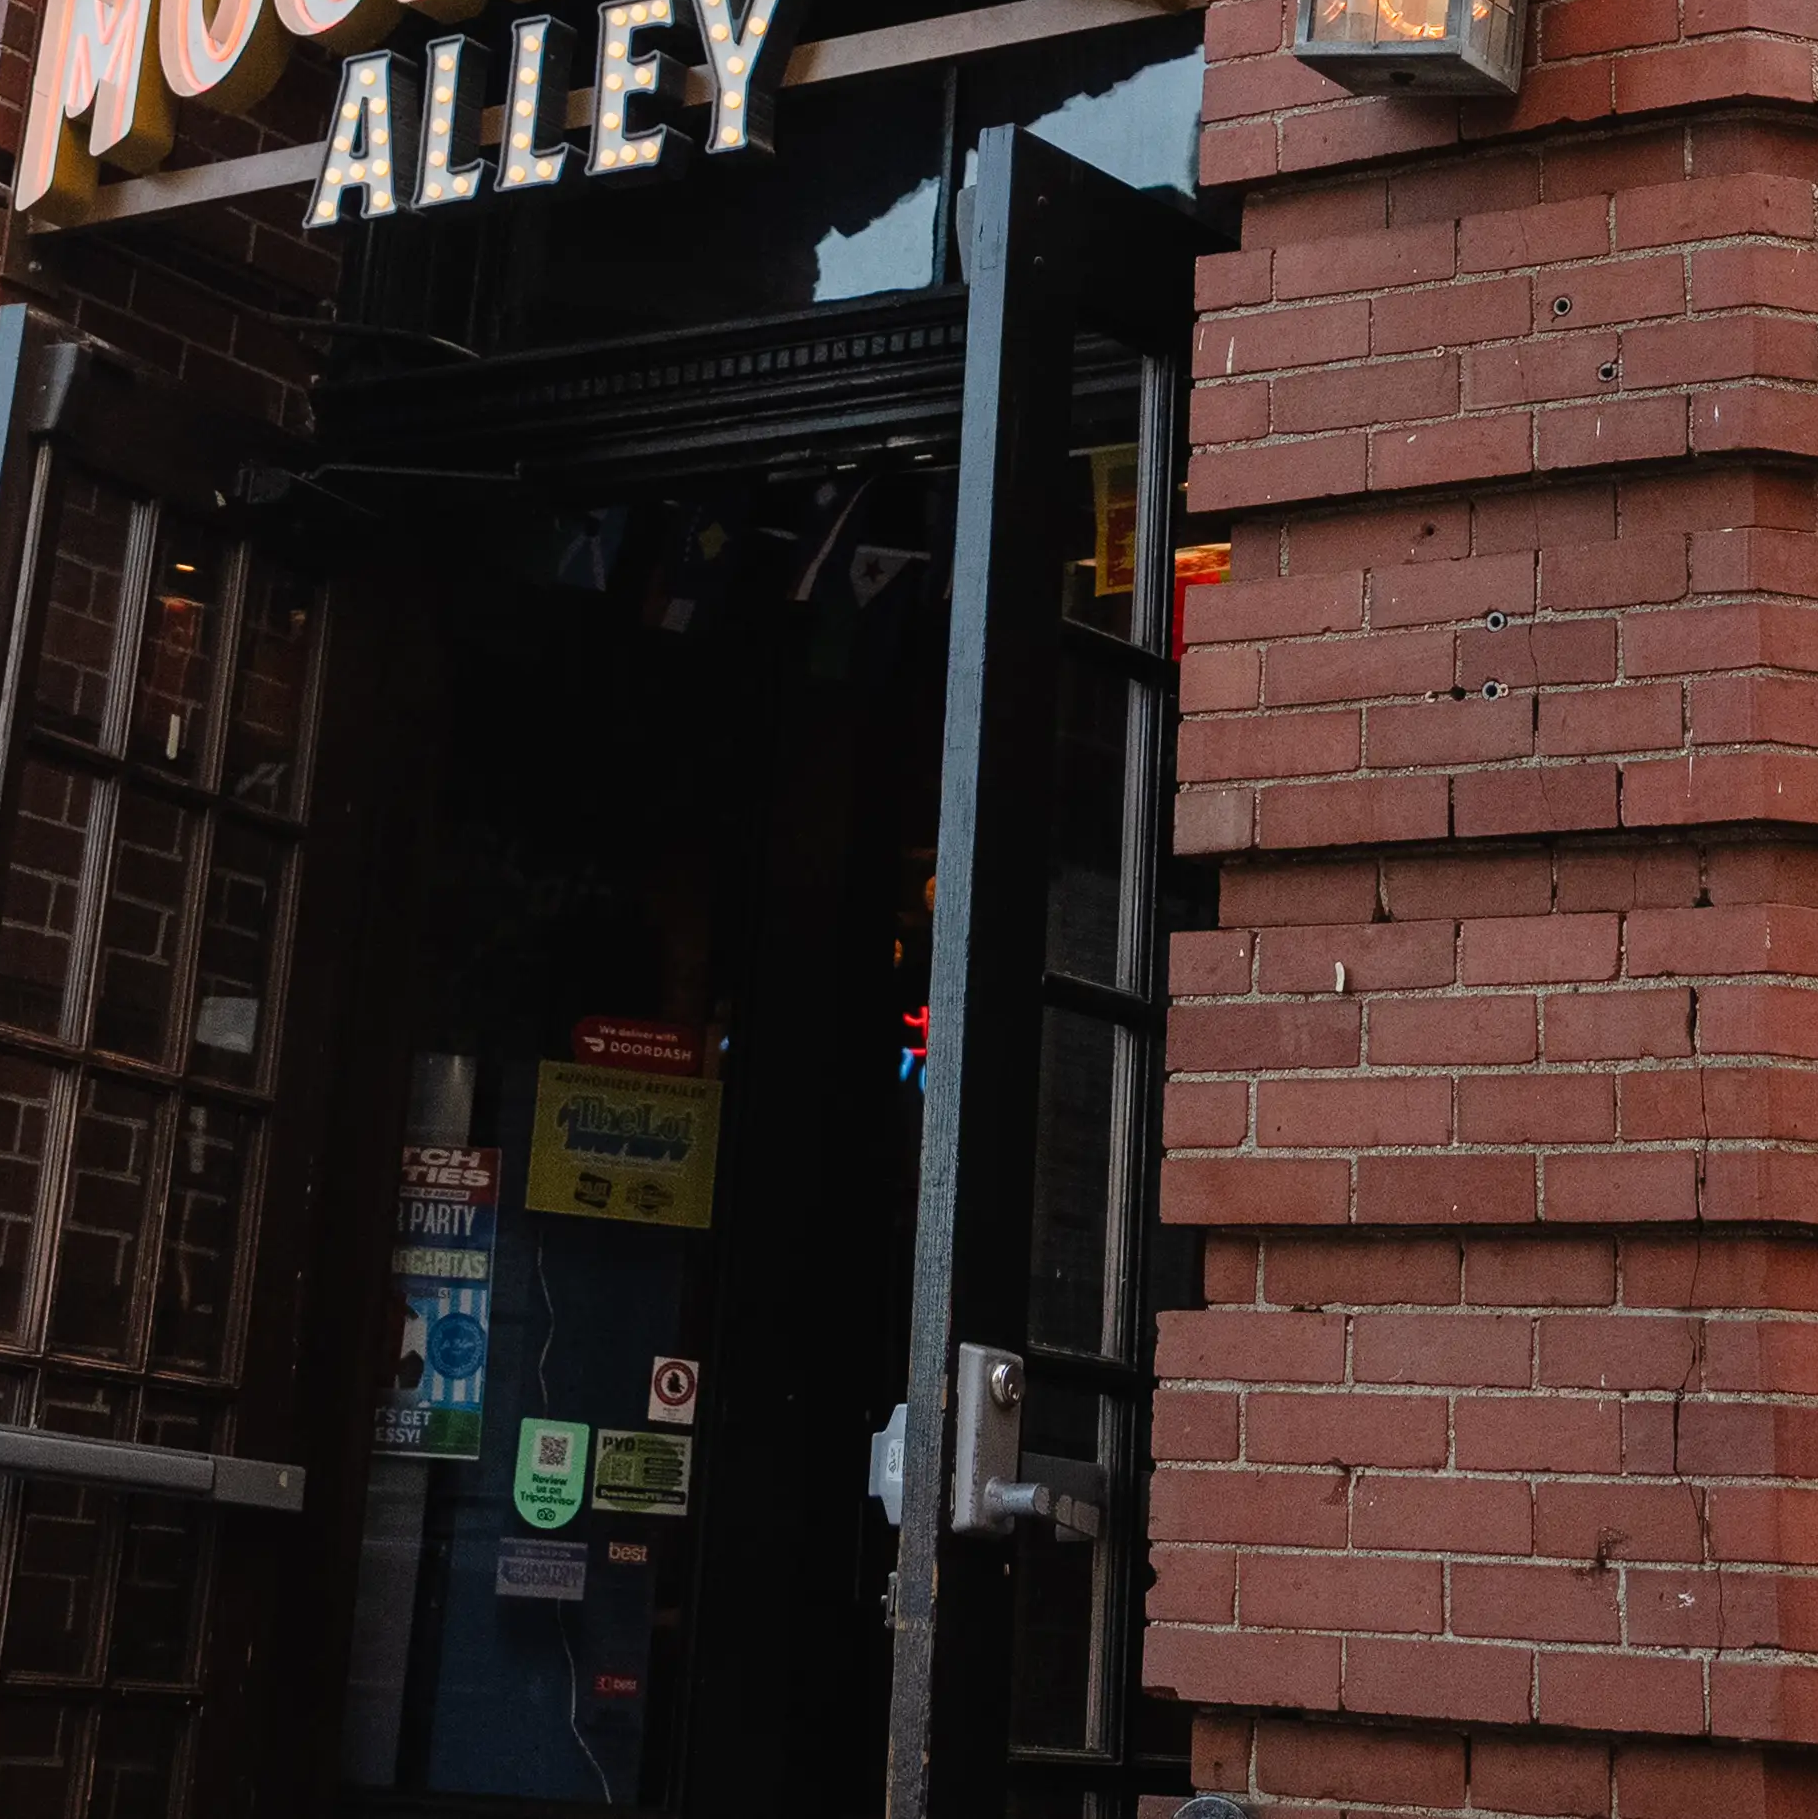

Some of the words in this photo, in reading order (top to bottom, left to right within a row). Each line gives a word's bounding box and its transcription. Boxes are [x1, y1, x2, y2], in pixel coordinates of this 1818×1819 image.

[618, 1029, 653, 1039] deliver
[655, 1033, 678, 1042] with
[609, 1041, 692, 1062] DOORDASH
[409, 1201, 477, 1236] PARTY
[400, 1409, 432, 1426] GET
[532, 1473, 568, 1486] Review
[535, 1485, 548, 1494] us
[549, 1487, 562, 1495] on
[520, 1491, 577, 1506] Tripadvisor
[609, 1541, 648, 1562] best
